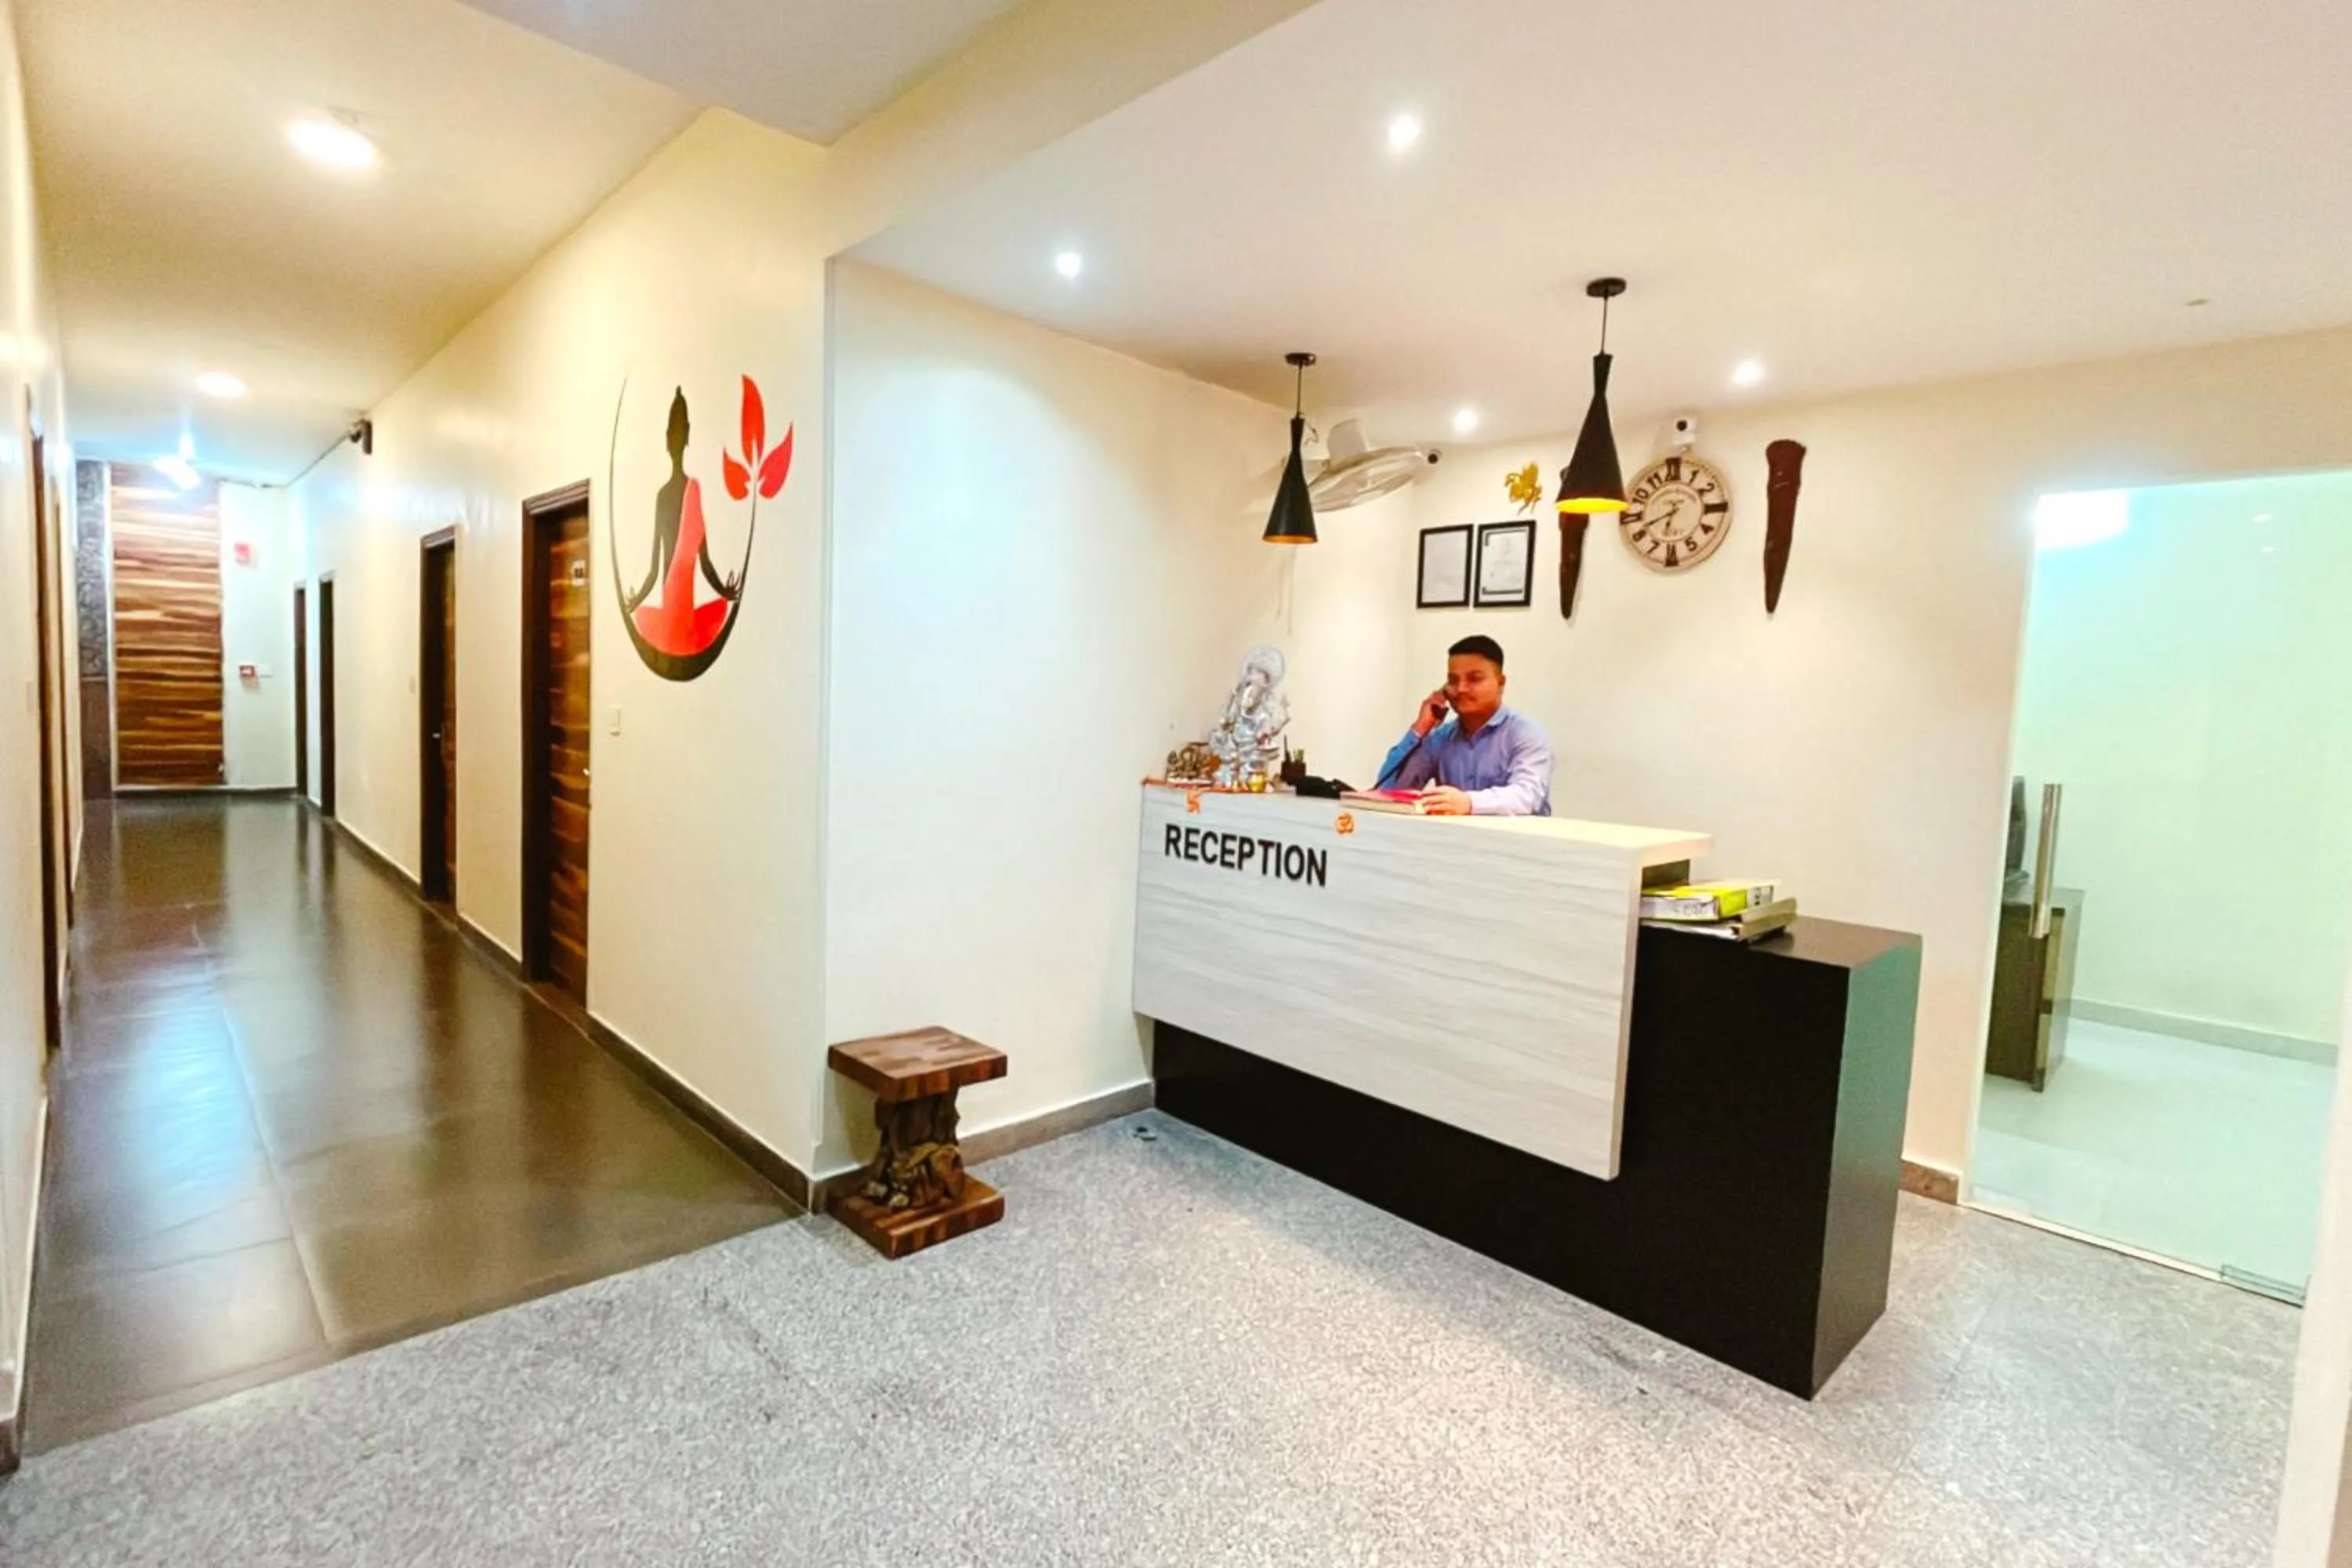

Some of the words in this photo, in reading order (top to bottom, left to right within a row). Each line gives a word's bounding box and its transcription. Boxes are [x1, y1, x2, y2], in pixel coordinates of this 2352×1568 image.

[1632, 488, 1649, 504] 10
[1697, 482, 1715, 496] 2
[1647, 539, 1661, 554] 7
[1685, 536, 1697, 551] 5
[1165, 824, 1327, 887] RECEPTION
